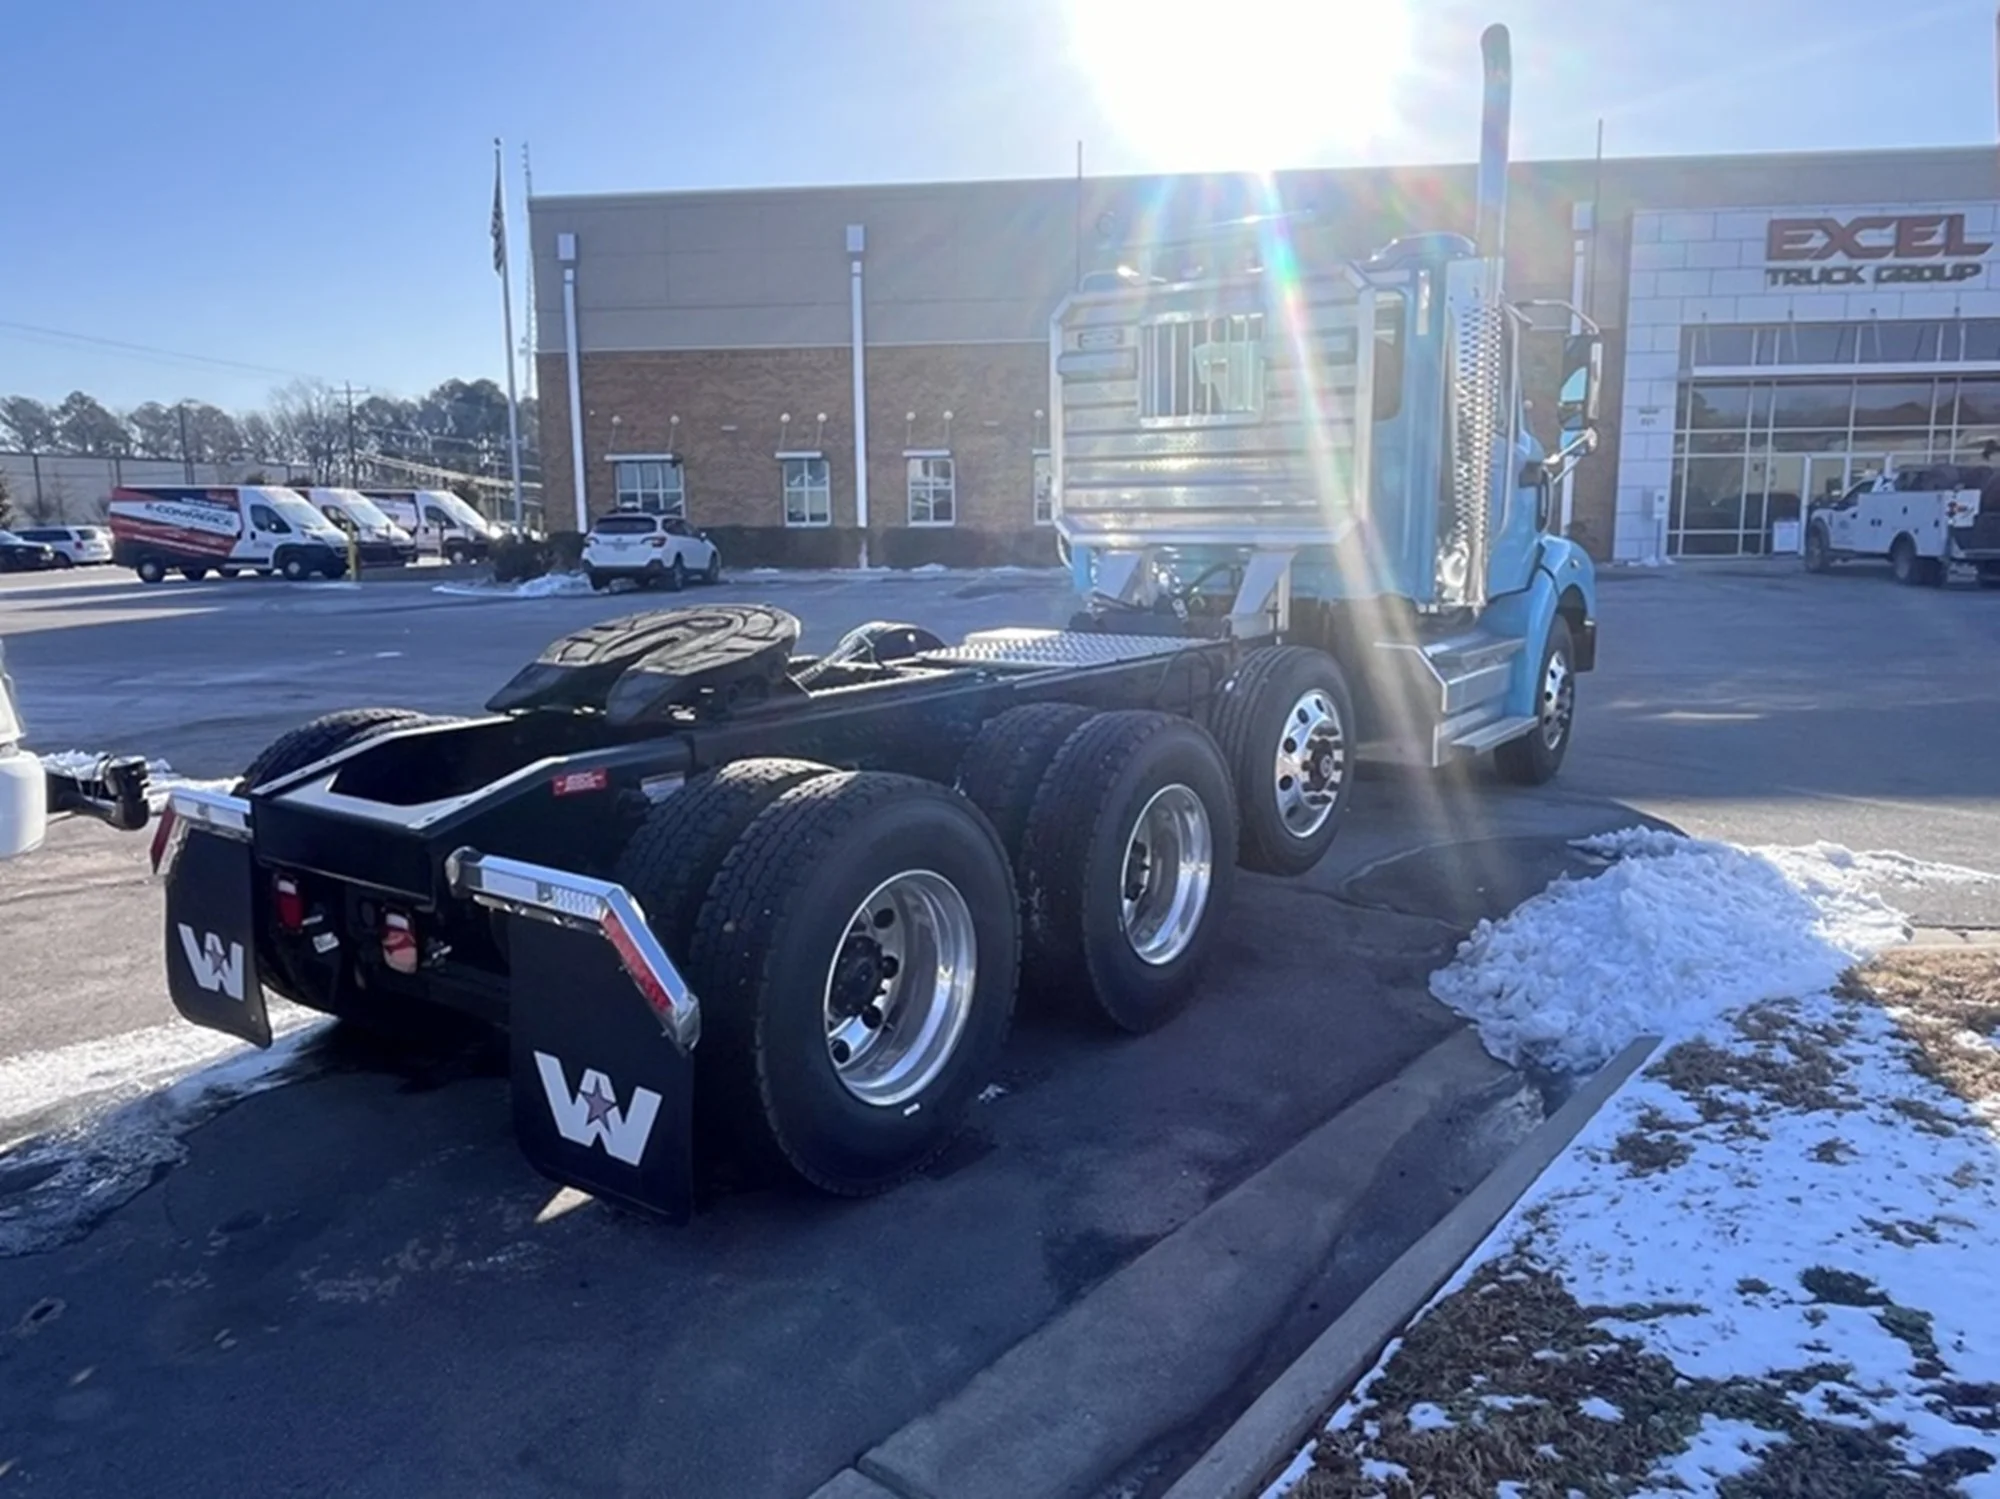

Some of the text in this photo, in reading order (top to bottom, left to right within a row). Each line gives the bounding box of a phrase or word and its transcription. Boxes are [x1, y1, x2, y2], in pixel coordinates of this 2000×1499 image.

[1766, 213, 1994, 262] EXCEL
[1765, 263, 1983, 286] TRUCK GROUP
